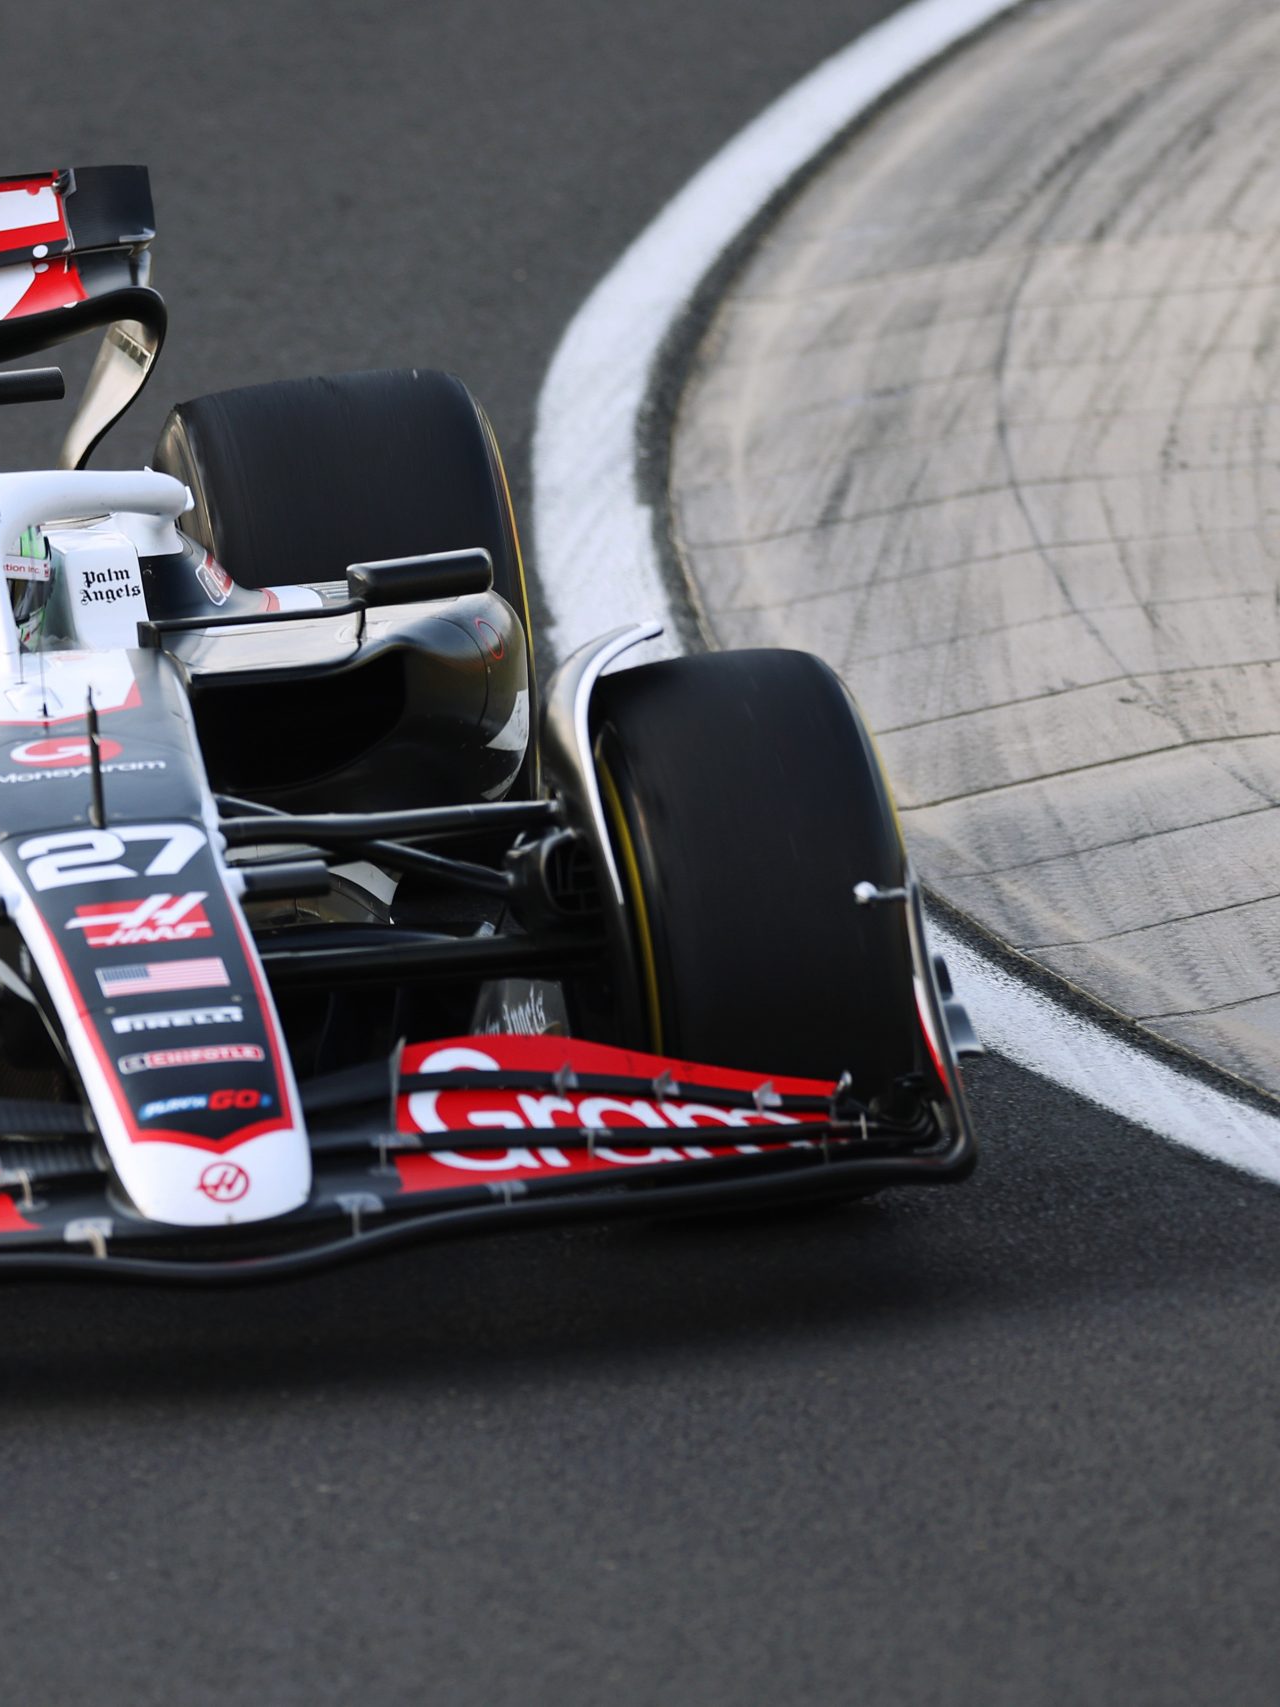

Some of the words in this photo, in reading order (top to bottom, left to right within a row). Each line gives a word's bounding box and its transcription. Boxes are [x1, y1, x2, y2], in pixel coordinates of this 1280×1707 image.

[82, 568, 130, 589] Palm
[80, 584, 141, 606] Angels
[18, 823, 208, 892] 27
[111, 1006, 244, 1034] PIRELLI
[150, 1046, 260, 1066] CHIPOTLE
[408, 1046, 812, 1171] Gram
